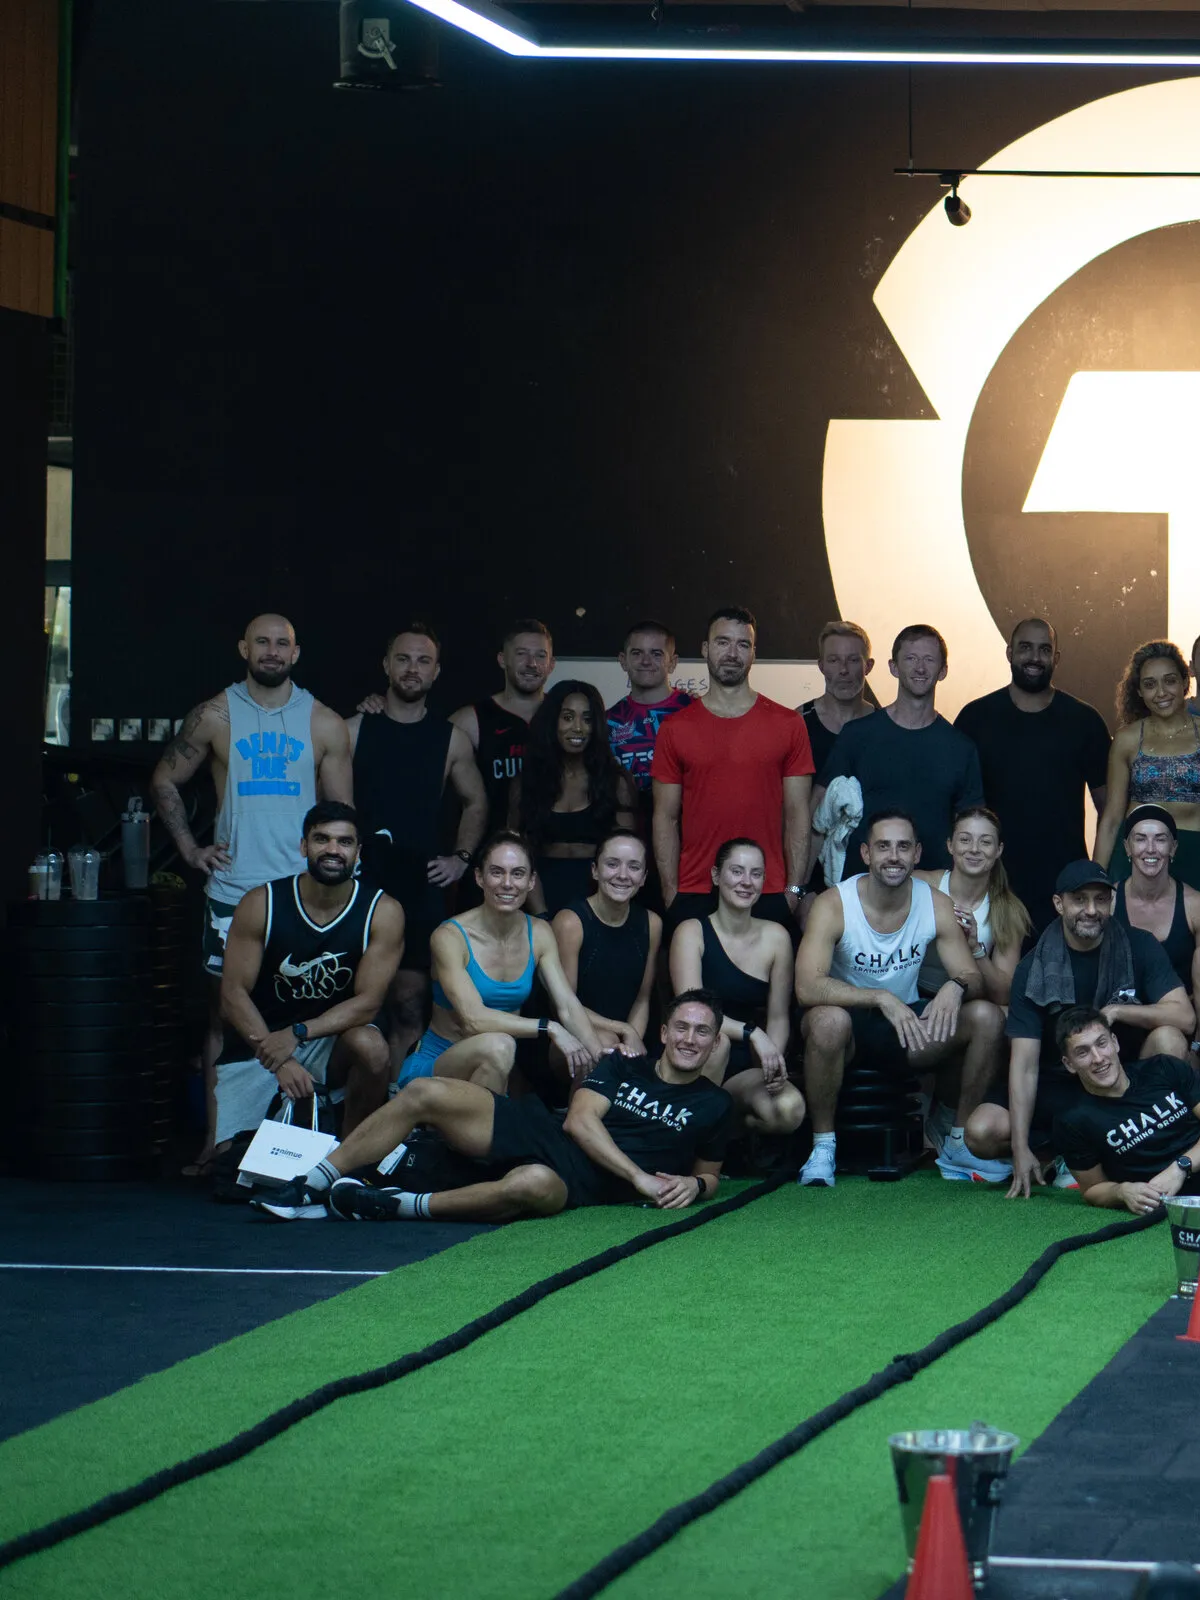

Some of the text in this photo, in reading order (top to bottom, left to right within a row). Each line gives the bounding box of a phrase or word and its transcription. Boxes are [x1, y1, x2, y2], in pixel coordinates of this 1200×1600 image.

[252, 757, 287, 779] DUE
[855, 944, 920, 967] CHALK
[893, 958, 921, 971] GROUND
[616, 1081, 693, 1126] CHALK
[1106, 1091, 1184, 1147] CHALK
[1115, 1106, 1188, 1155] TRAINING GROUND
[279, 1149, 303, 1159] nimue
